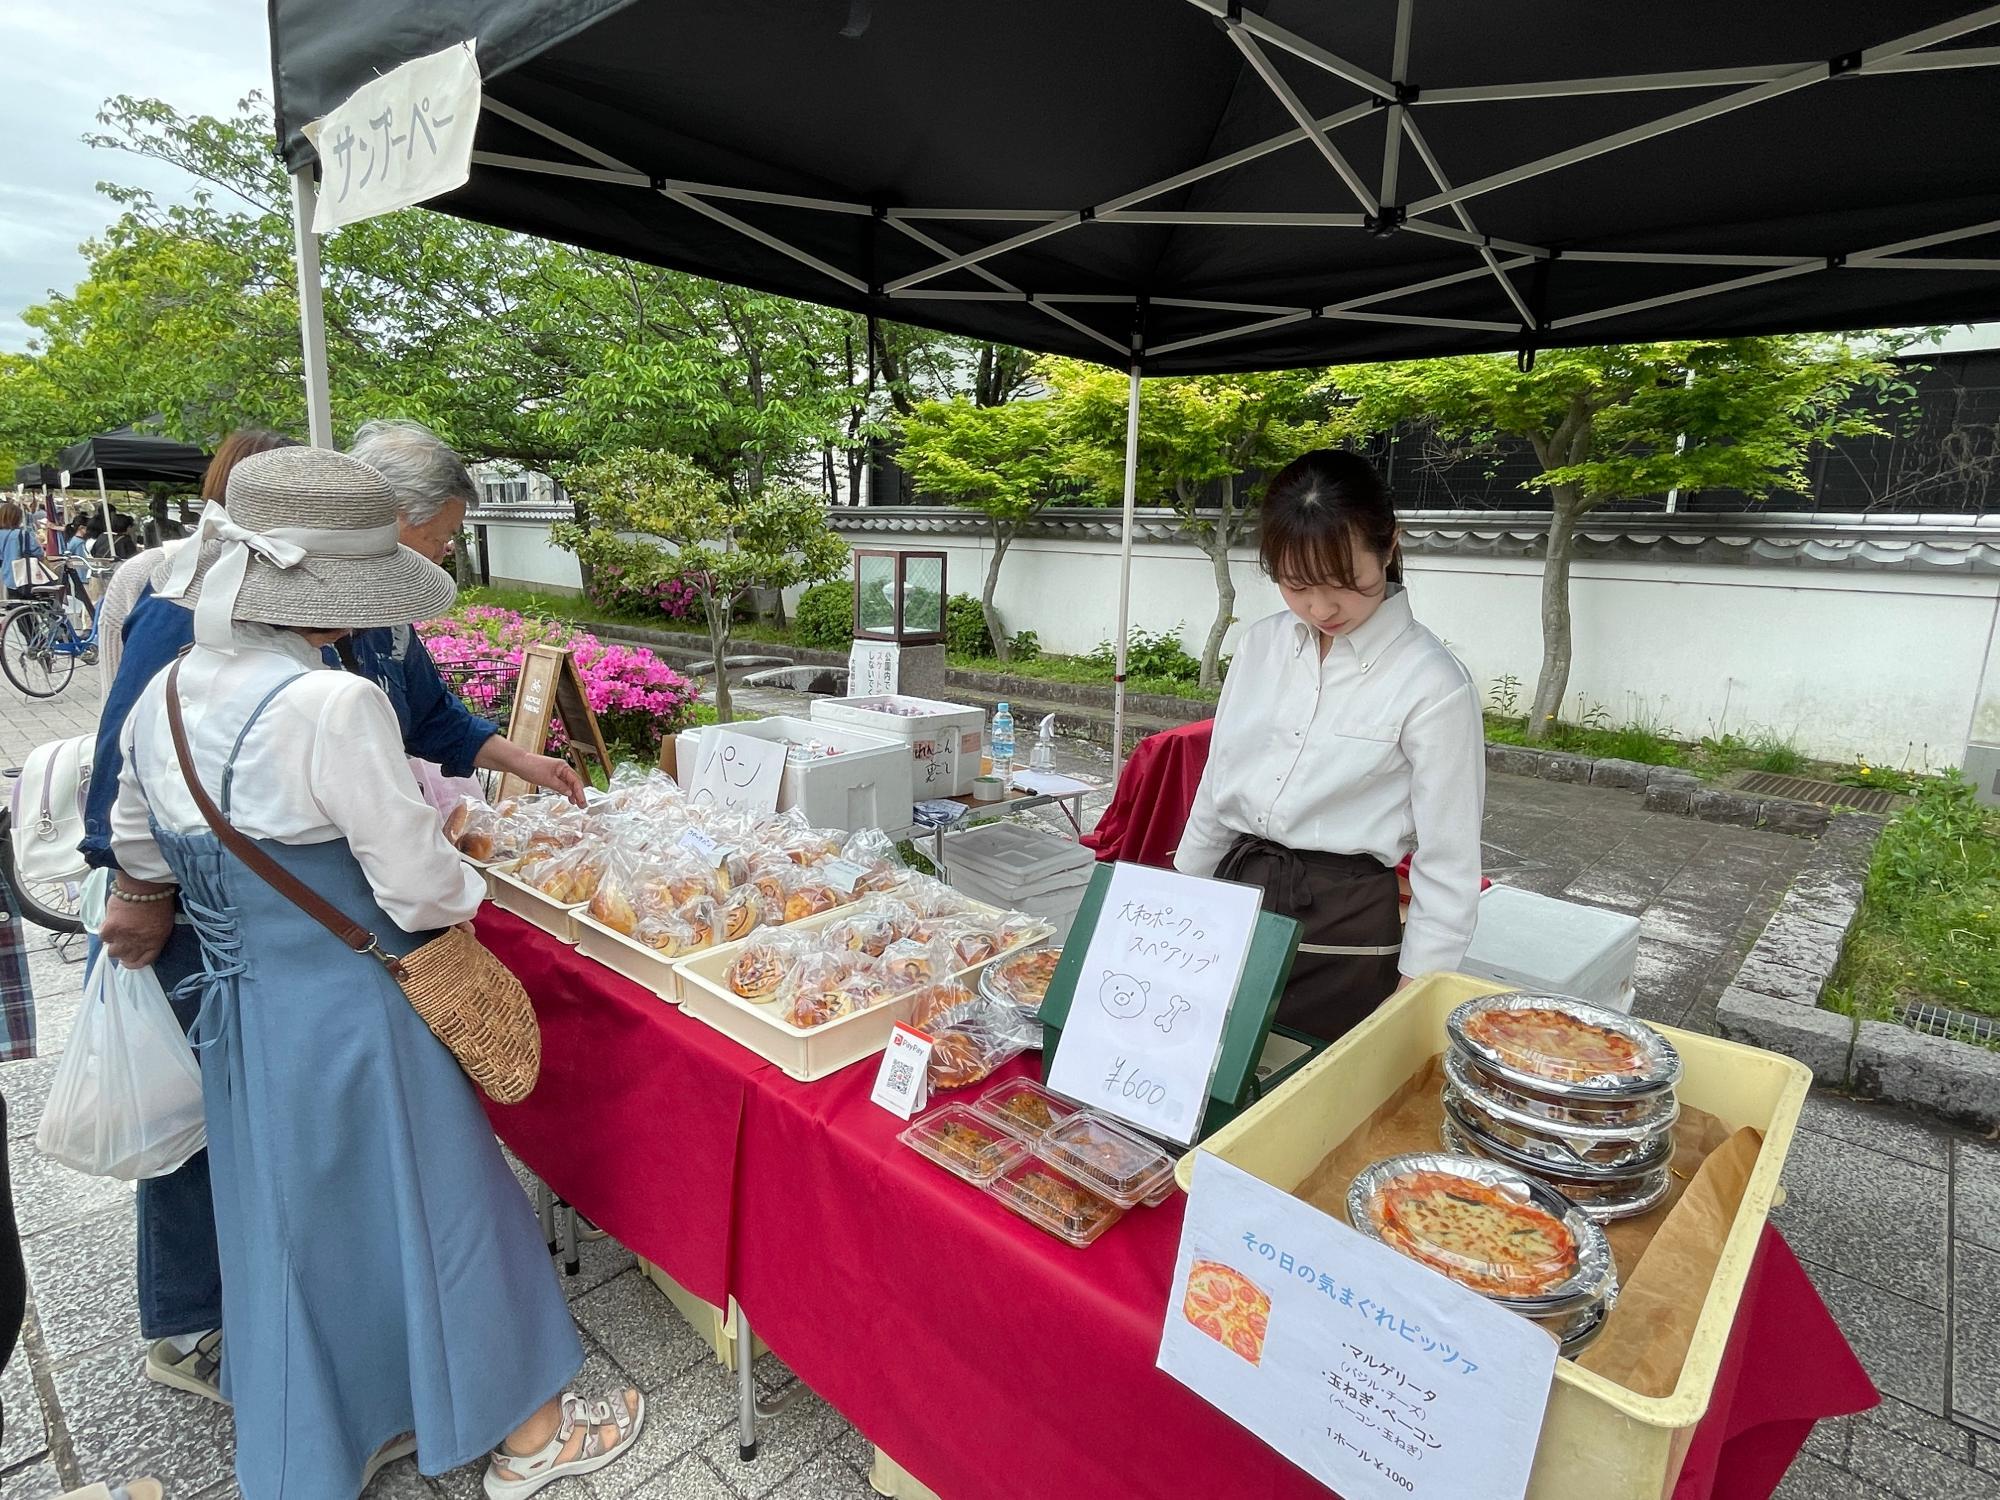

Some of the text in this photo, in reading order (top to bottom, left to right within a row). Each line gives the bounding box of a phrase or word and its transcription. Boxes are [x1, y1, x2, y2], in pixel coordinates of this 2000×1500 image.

[333, 97, 454, 203] サンプーペー
[704, 746, 761, 787] パン
[1117, 900, 1205, 940] 大和ポークの
[1129, 937, 1220, 974] スペアリブ
[902, 1039, 925, 1057] PayPay
[1105, 1056, 1166, 1105] ¥600
[1242, 1231, 1479, 1375] その日の気まぐれピッツァ
